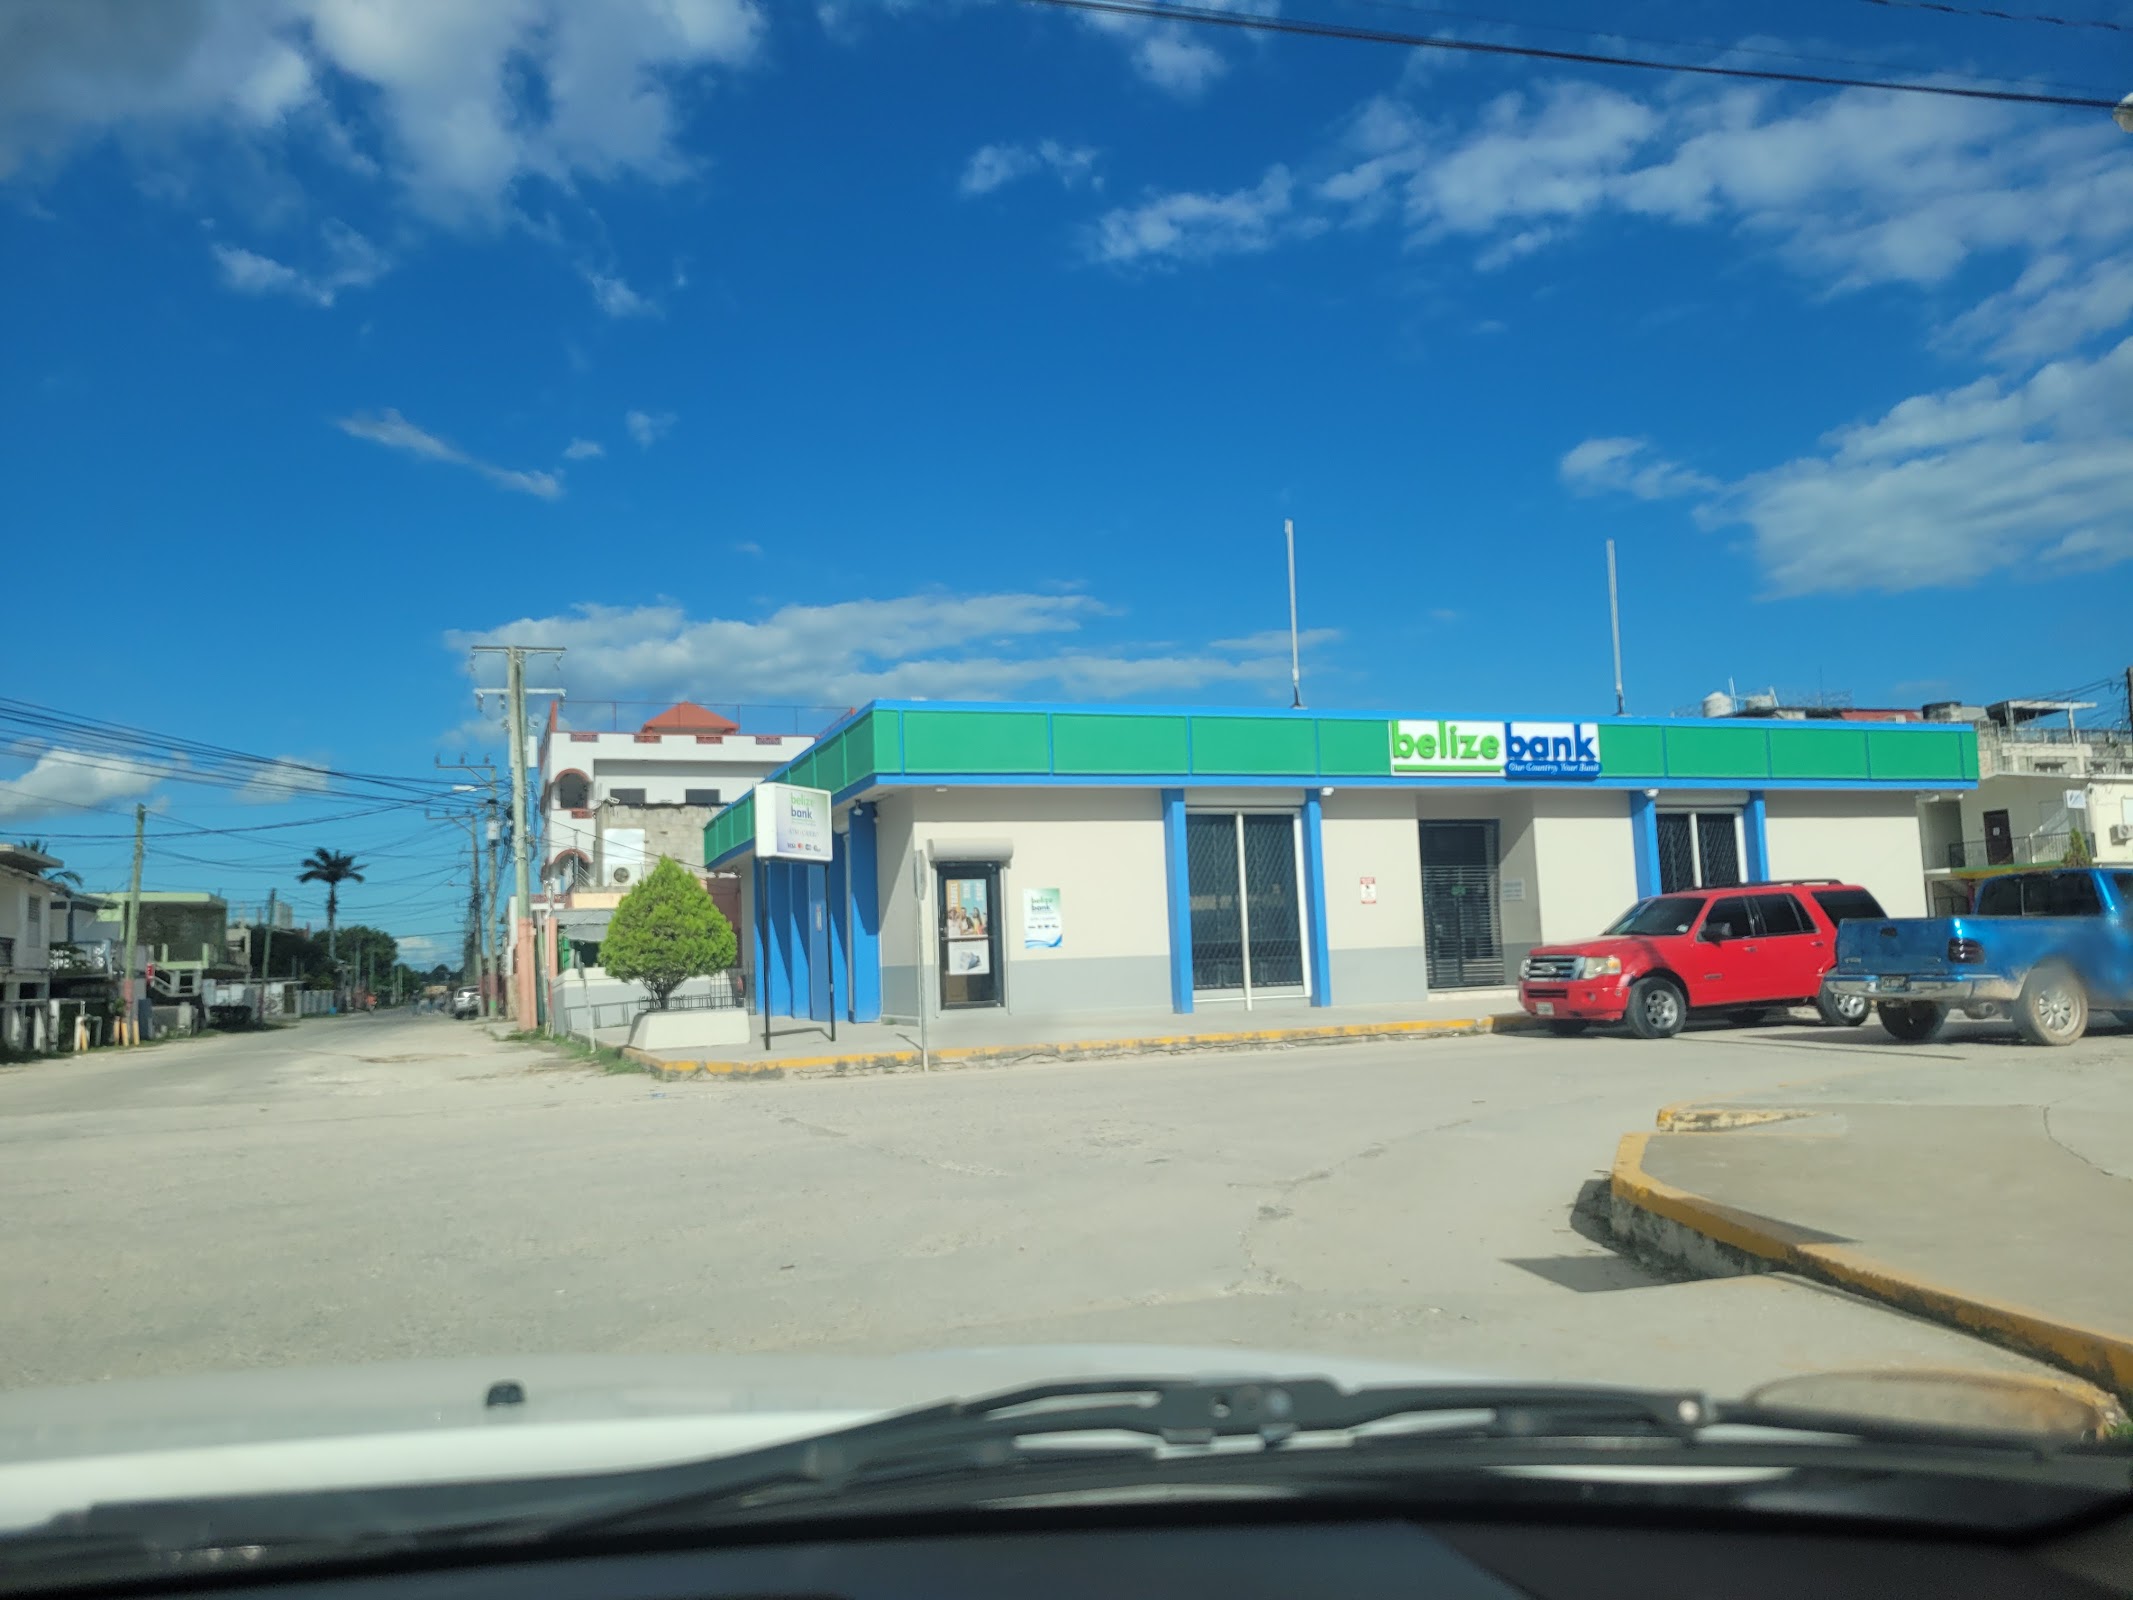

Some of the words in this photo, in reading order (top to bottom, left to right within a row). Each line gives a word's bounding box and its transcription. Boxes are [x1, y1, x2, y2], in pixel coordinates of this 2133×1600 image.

[1392, 719, 1500, 759] belize
[1504, 722, 1597, 760] bank
[791, 792, 816, 806] belize
[791, 805, 812, 820] bank
[1031, 903, 1051, 911] bank
